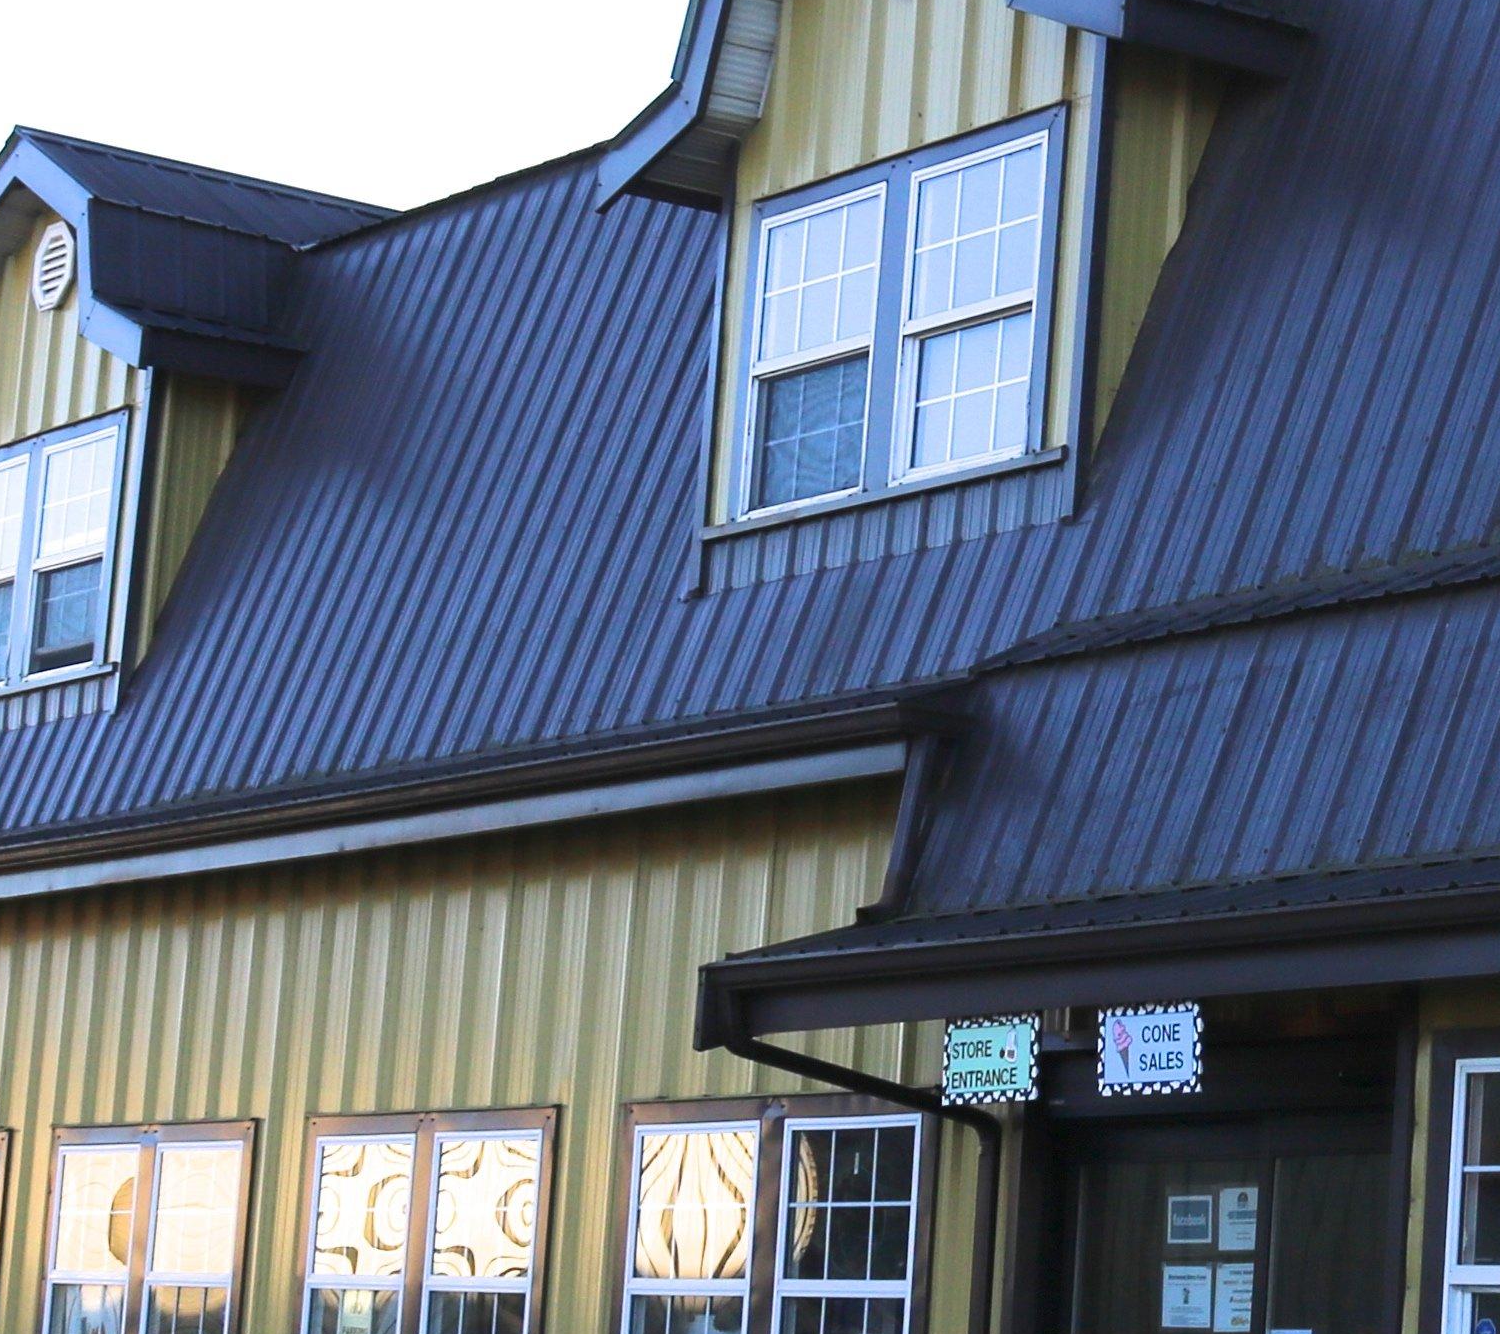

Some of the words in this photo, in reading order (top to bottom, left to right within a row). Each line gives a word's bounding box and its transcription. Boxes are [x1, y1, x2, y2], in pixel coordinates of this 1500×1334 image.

[1141, 1023, 1181, 1044] CONE
[952, 1040, 992, 1060] STORE
[1139, 1051, 1184, 1072] SALES
[951, 1067, 1017, 1089] ENTRANCE
